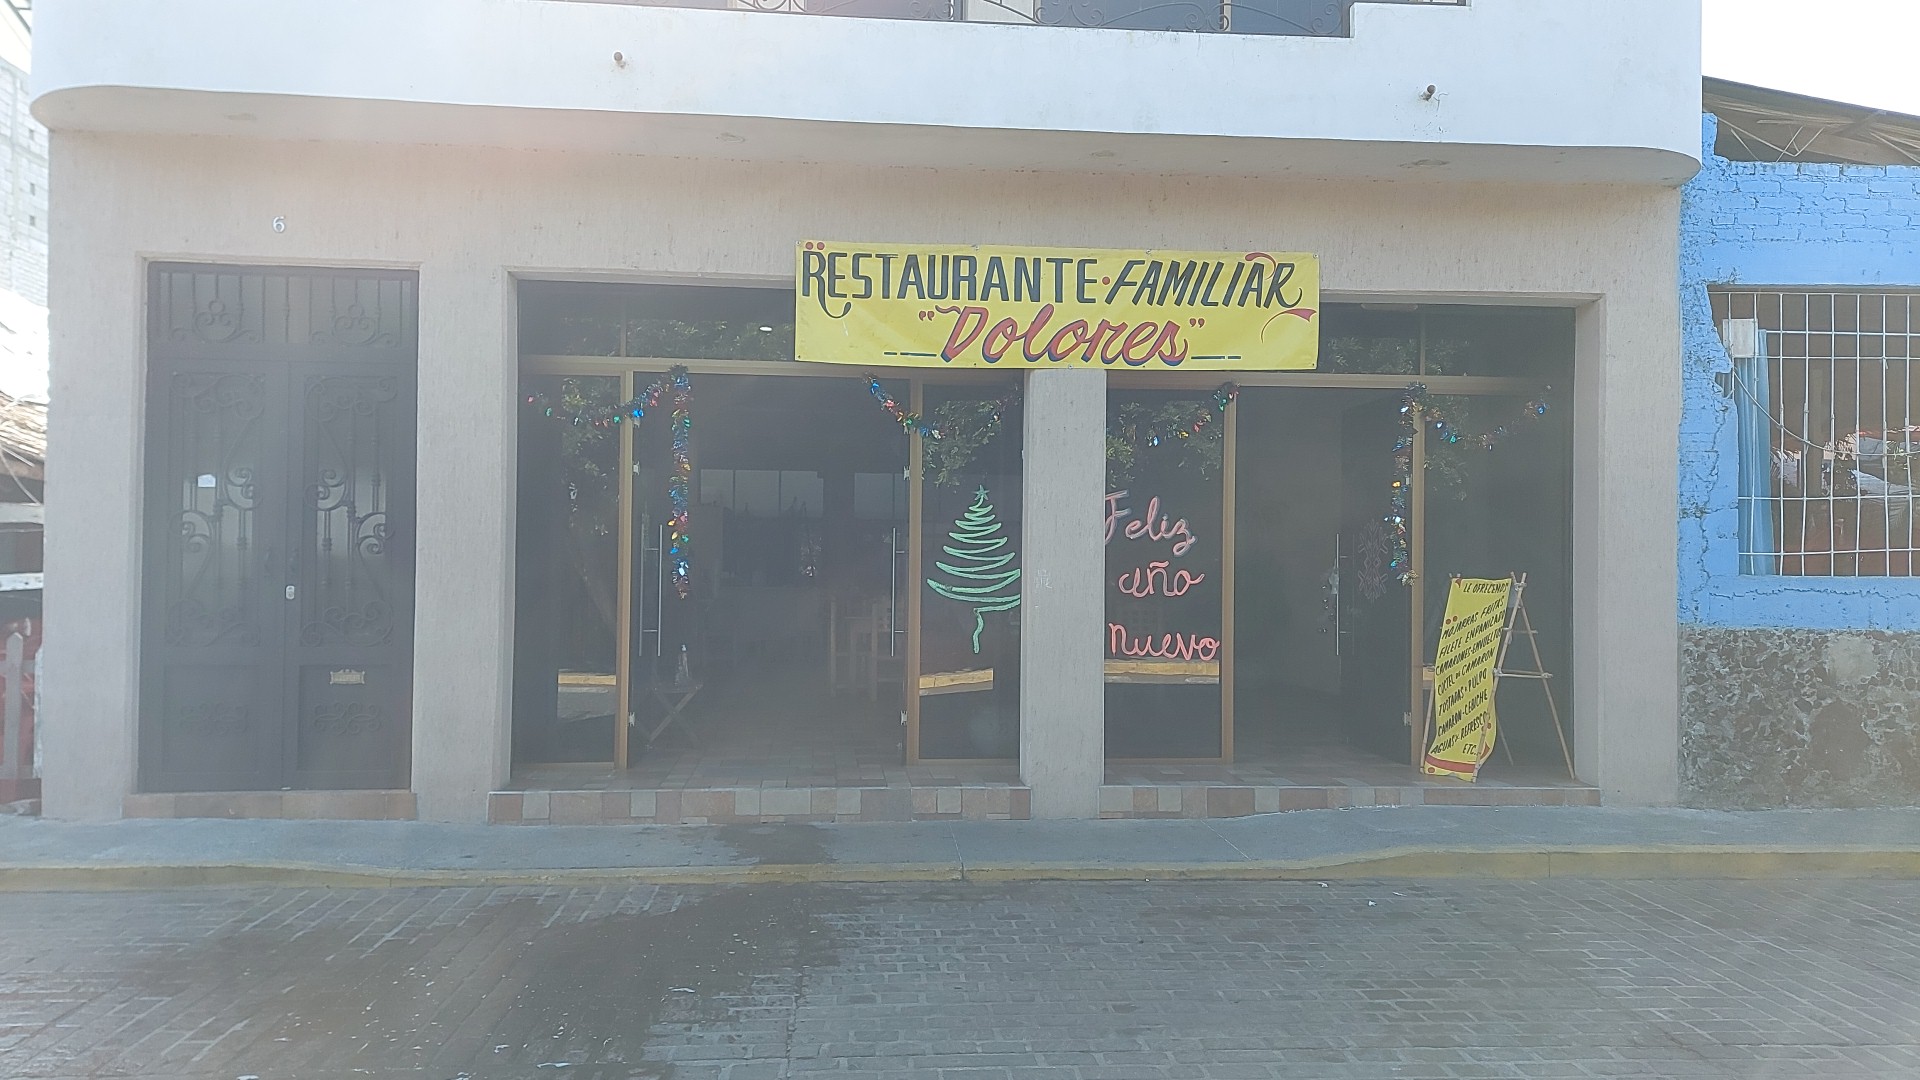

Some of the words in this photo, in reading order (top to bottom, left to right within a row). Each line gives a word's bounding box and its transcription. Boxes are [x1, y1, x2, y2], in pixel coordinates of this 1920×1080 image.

[272, 215, 285, 233] 6
[801, 248, 1098, 318] RESTAURANTE
[1104, 259, 1303, 310] FAMILIAR
[1104, 489, 1198, 556] Feliz
[1118, 560, 1206, 598] año
[1463, 582, 1473, 593] LE
[1472, 582, 1509, 594] OFRECEMOS
[1441, 611, 1479, 640] MOJARRAS
[1438, 636, 1463, 659] FILETE
[1461, 646, 1496, 676] CAMARON
[1467, 667, 1487, 693] PULPO
[1430, 734, 1457, 755] AGUAS
